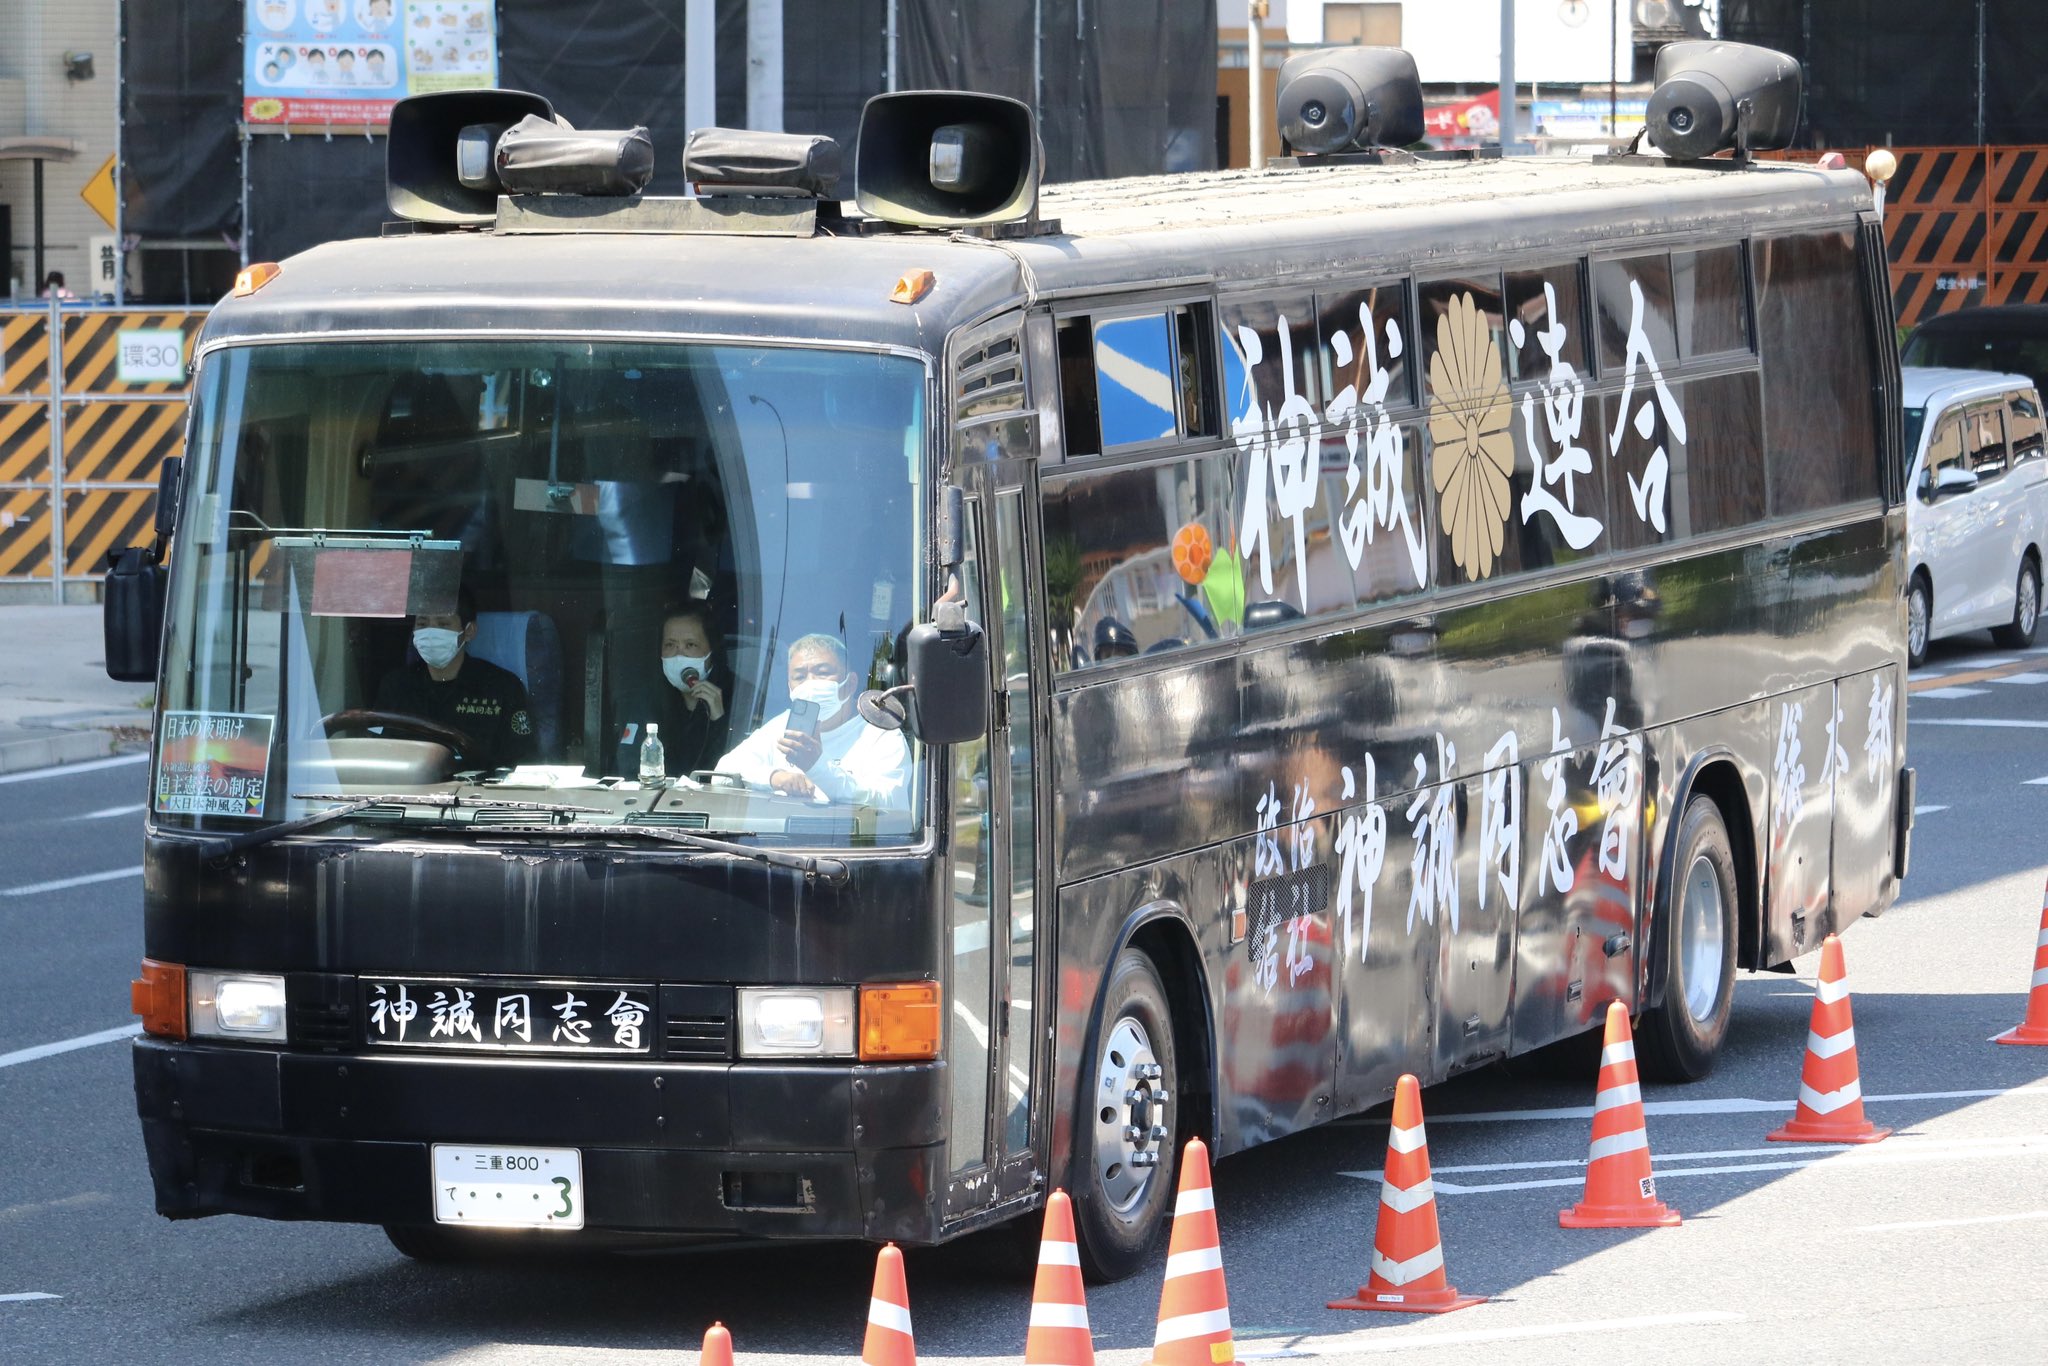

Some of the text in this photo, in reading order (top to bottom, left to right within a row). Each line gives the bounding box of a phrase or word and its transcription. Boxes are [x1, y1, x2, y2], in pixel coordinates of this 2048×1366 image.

[1508, 279, 1687, 550] 連合
[167, 717, 245, 740] 日本の夜明け
[160, 775, 264, 799] 自主憲法の制定
[171, 797, 244, 814] 大日本神風会
[369, 983, 650, 1049] 神誠同志會
[474, 1154, 539, 1171] 三重800
